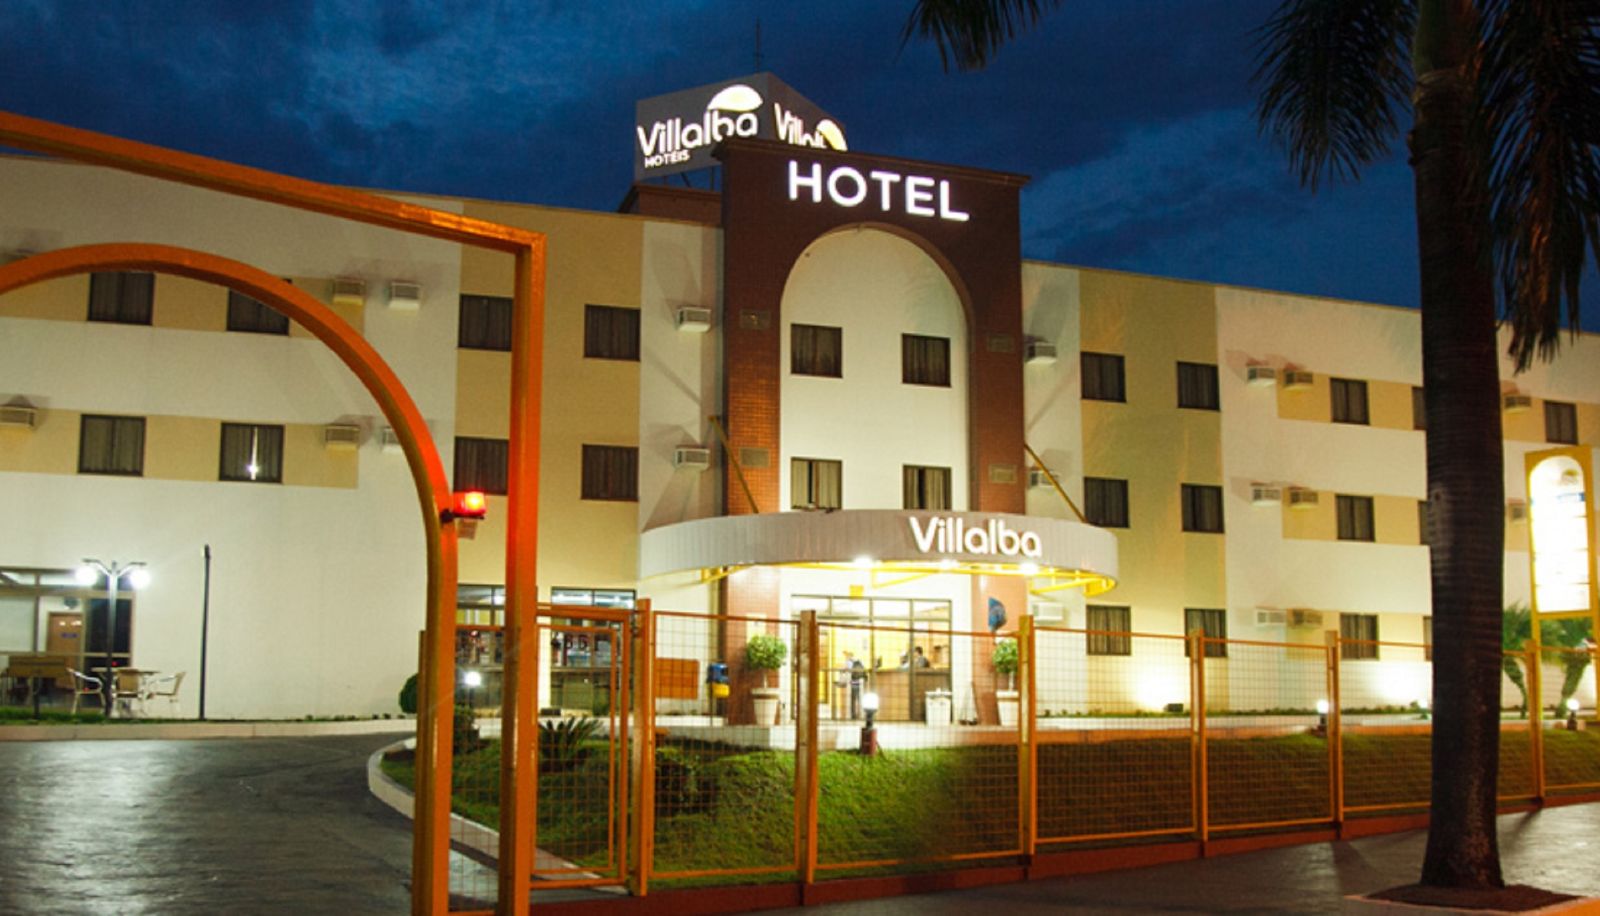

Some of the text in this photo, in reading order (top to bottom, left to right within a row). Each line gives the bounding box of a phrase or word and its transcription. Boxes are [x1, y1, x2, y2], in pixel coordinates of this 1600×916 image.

[636, 108, 759, 157] Villalba
[788, 159, 971, 223] HOTEL
[908, 515, 1044, 559] Villalba
